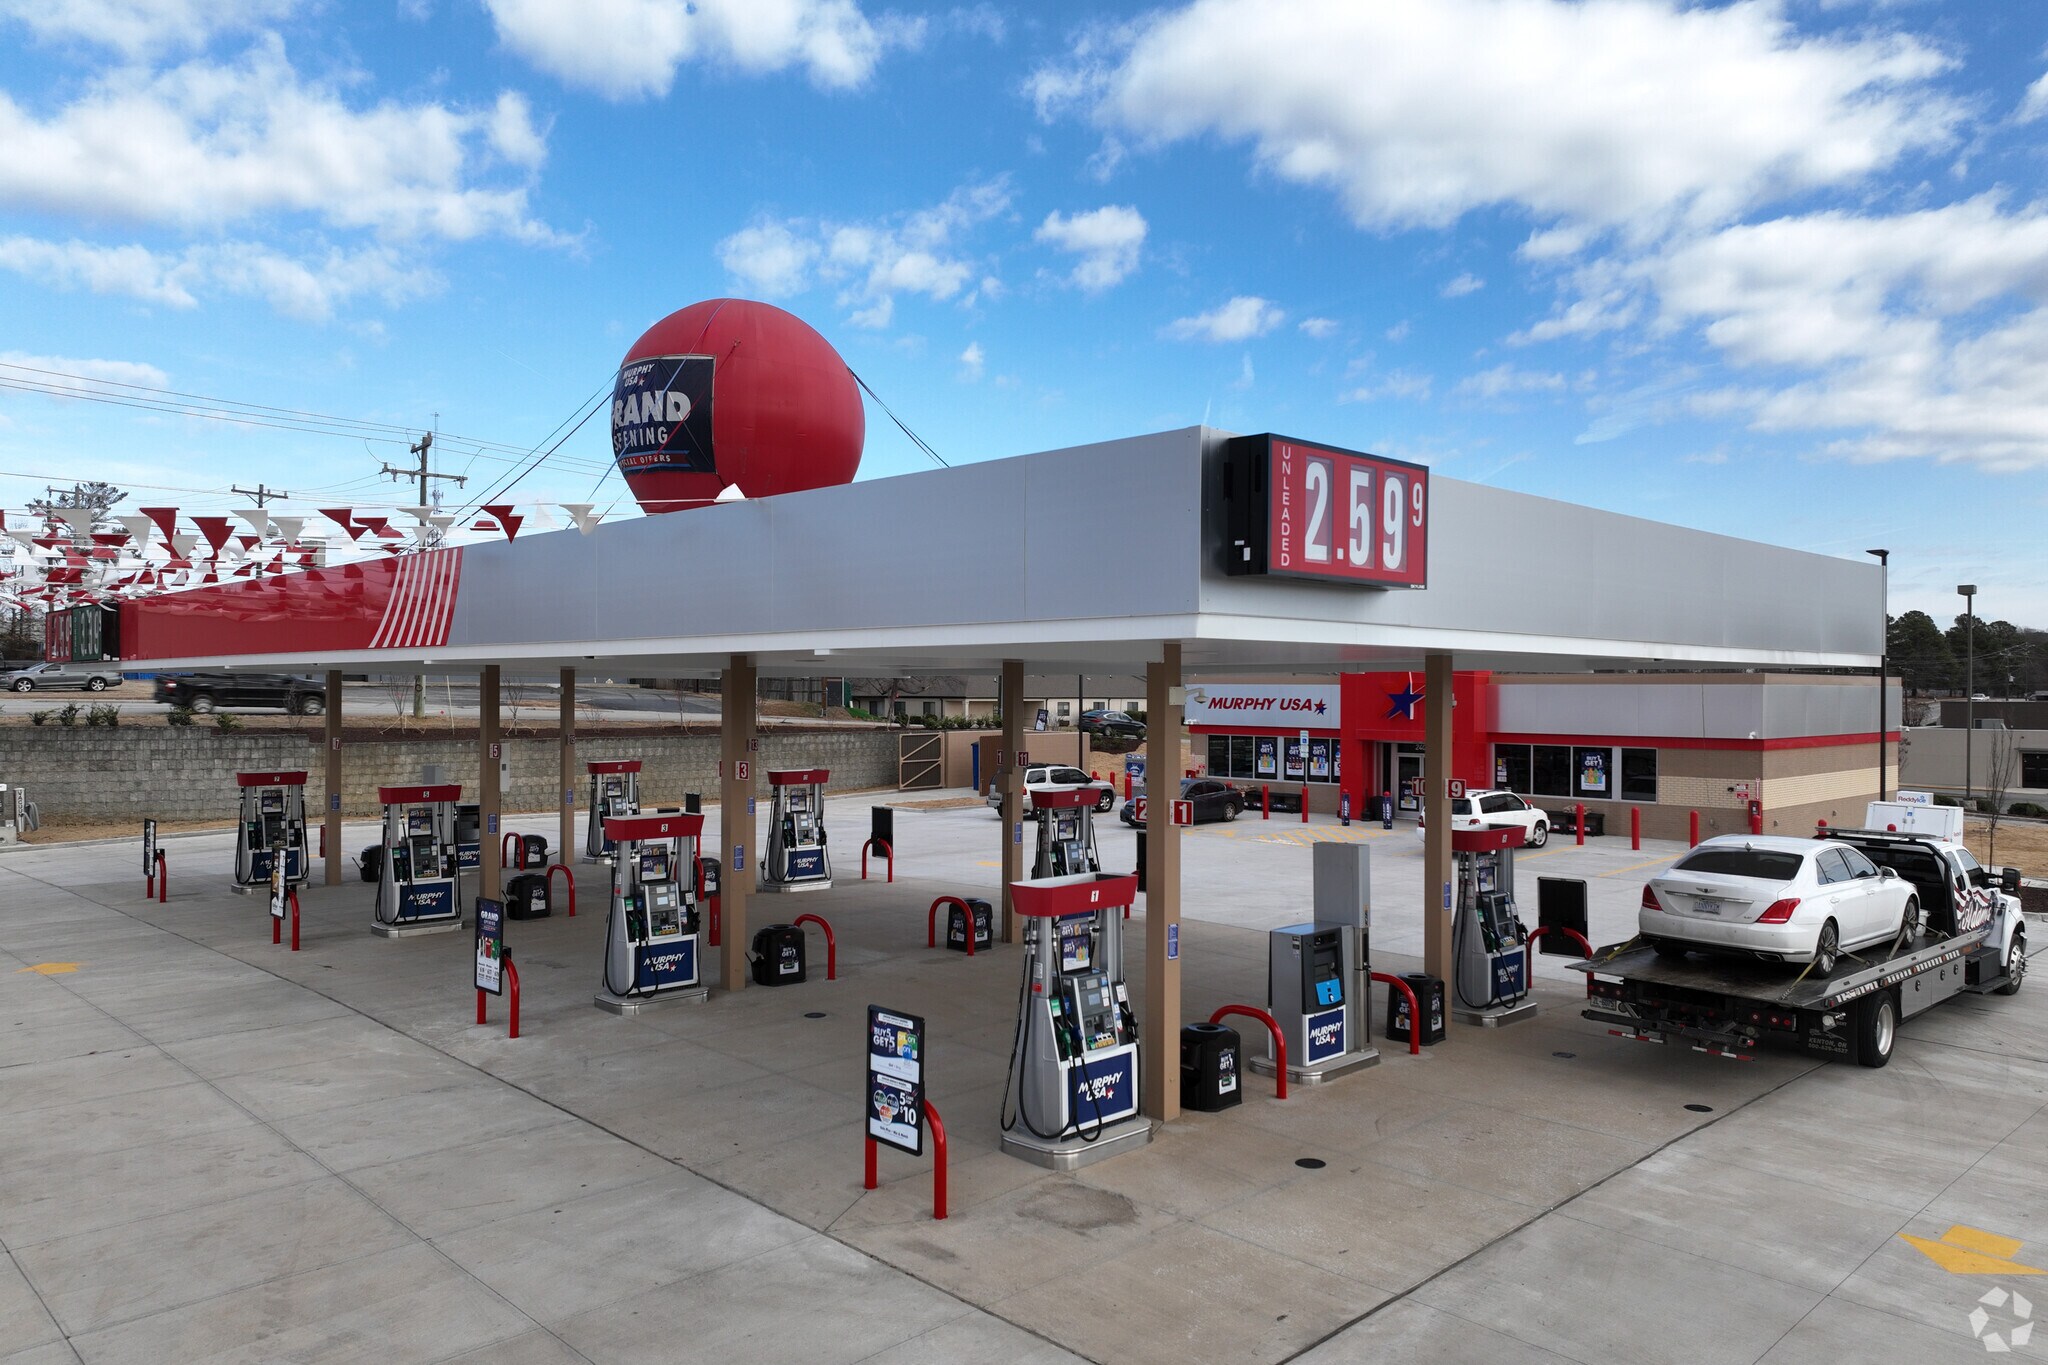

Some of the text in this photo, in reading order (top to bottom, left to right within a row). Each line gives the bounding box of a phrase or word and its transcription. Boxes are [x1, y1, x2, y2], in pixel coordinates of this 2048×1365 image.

[623, 363, 655, 380] MURPHY
[624, 376, 638, 387] USA
[613, 390, 691, 429] RAND
[1281, 445, 1291, 567] UNLEADED
[1304, 461, 1404, 570] 2.59
[1208, 697, 1312, 711] MURPHY USA
[1020, 752, 1028, 766] 11
[741, 764, 746, 778] 3
[1452, 782, 1462, 797] 9
[1139, 800, 1147, 820] 2
[1179, 803, 1188, 823] 1
[408, 892, 444, 900] MURPHY
[480, 910, 498, 922] GRAND
[644, 952, 685, 966] MURPHY
[874, 1027, 886, 1036] BUY
[1309, 1020, 1343, 1040] MURPHY
[874, 1034, 888, 1048] GET
[889, 1036, 896, 1048] 5
[1316, 1034, 1331, 1046] USA
[1220, 1061, 1230, 1070] GET
[1078, 1072, 1123, 1094] MURPHY
[900, 1092, 906, 1106] 5
[900, 1106, 916, 1126] $10
